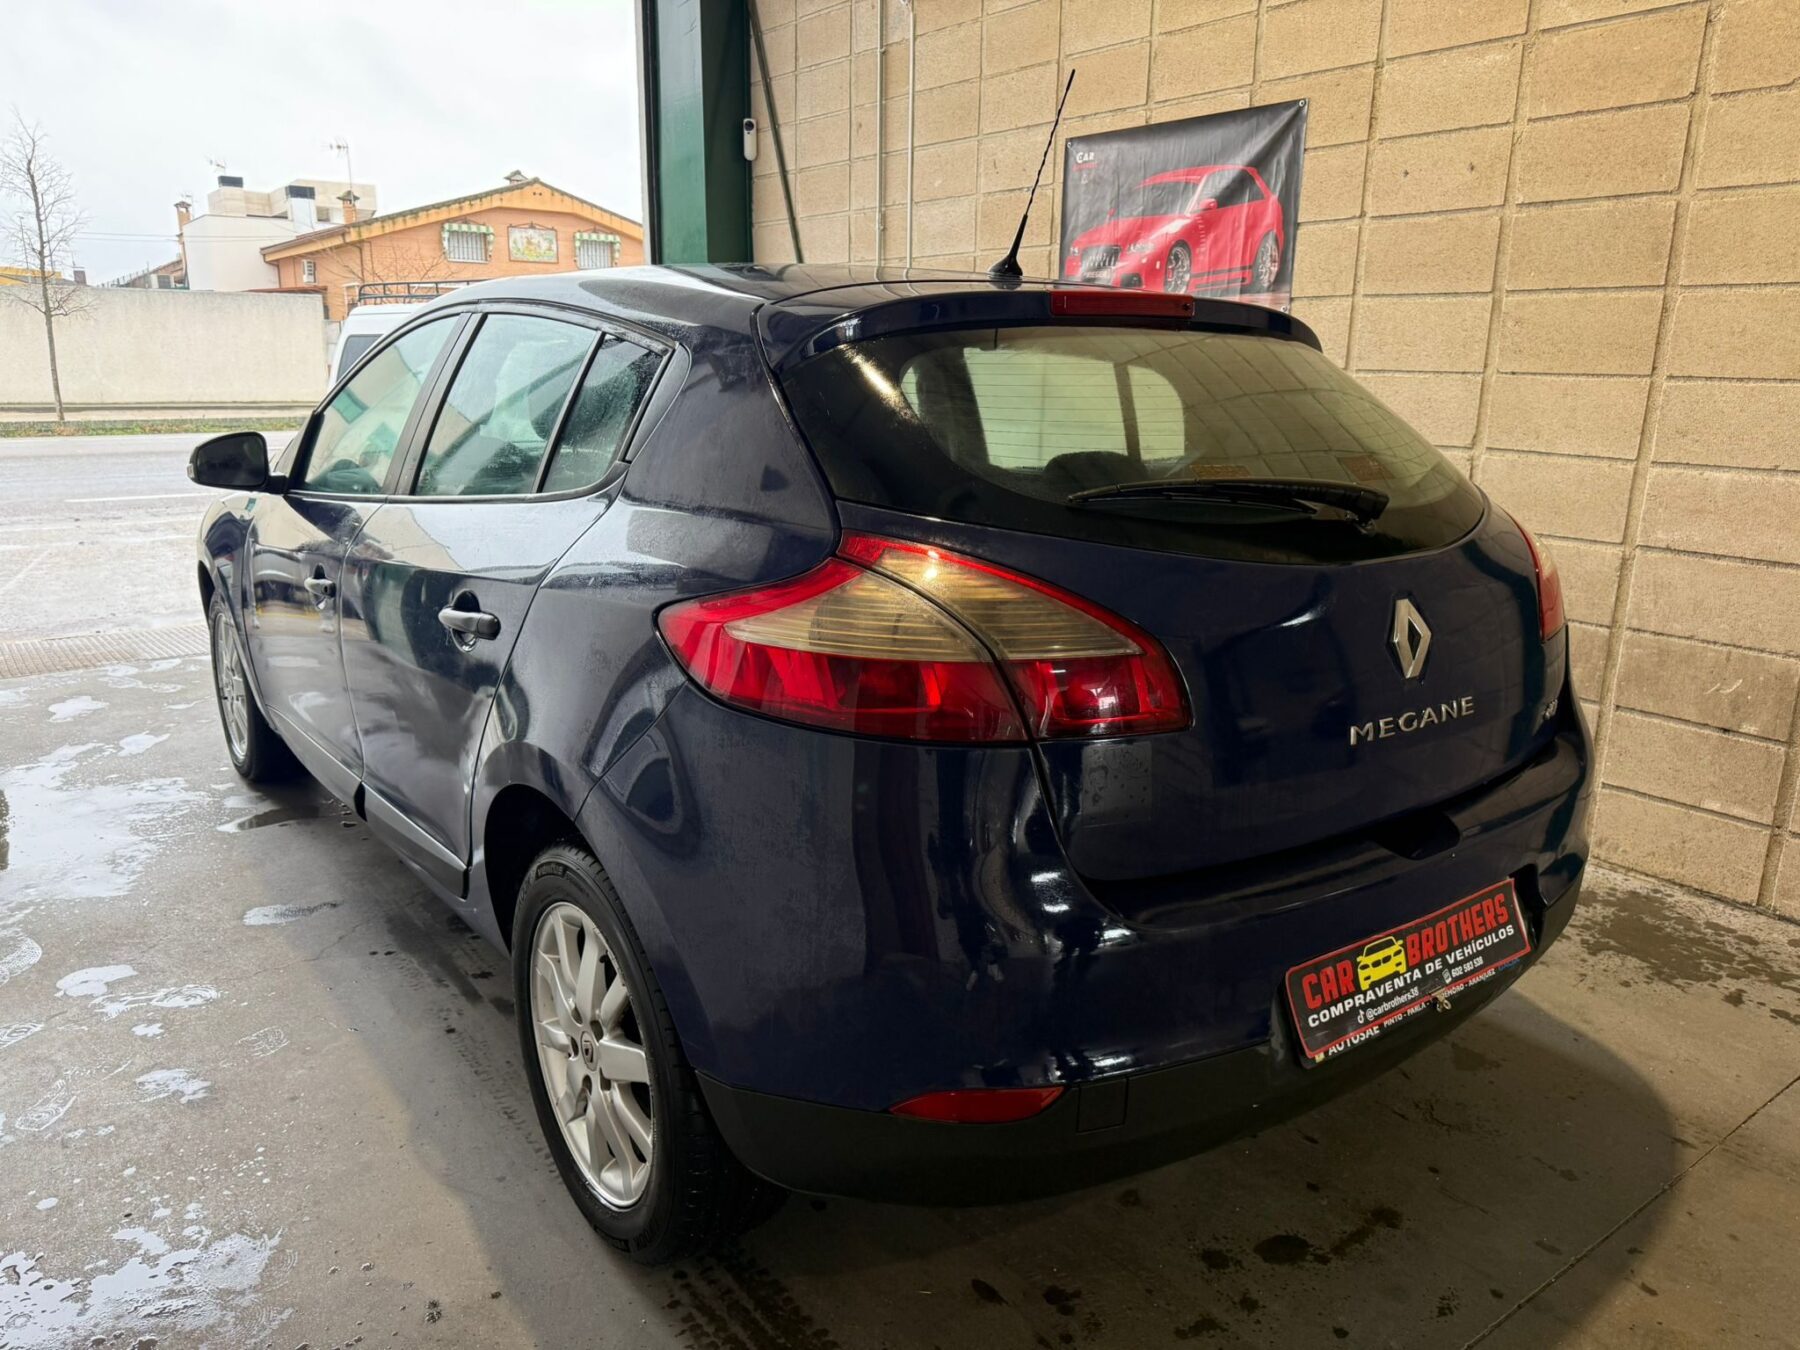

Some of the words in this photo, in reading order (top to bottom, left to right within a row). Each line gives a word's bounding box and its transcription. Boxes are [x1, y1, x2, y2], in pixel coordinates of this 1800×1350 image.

[1350, 696, 1474, 746] MEGANE
[1302, 959, 1356, 1009] CAR
[1406, 893, 1509, 967] BROTHERS
[1307, 969, 1423, 1028] COMPRAVENTA
[1424, 958, 1443, 975] DE
[1445, 924, 1515, 965] VEHÍCULOS
[1365, 986, 1419, 1021] @carbrothers38
